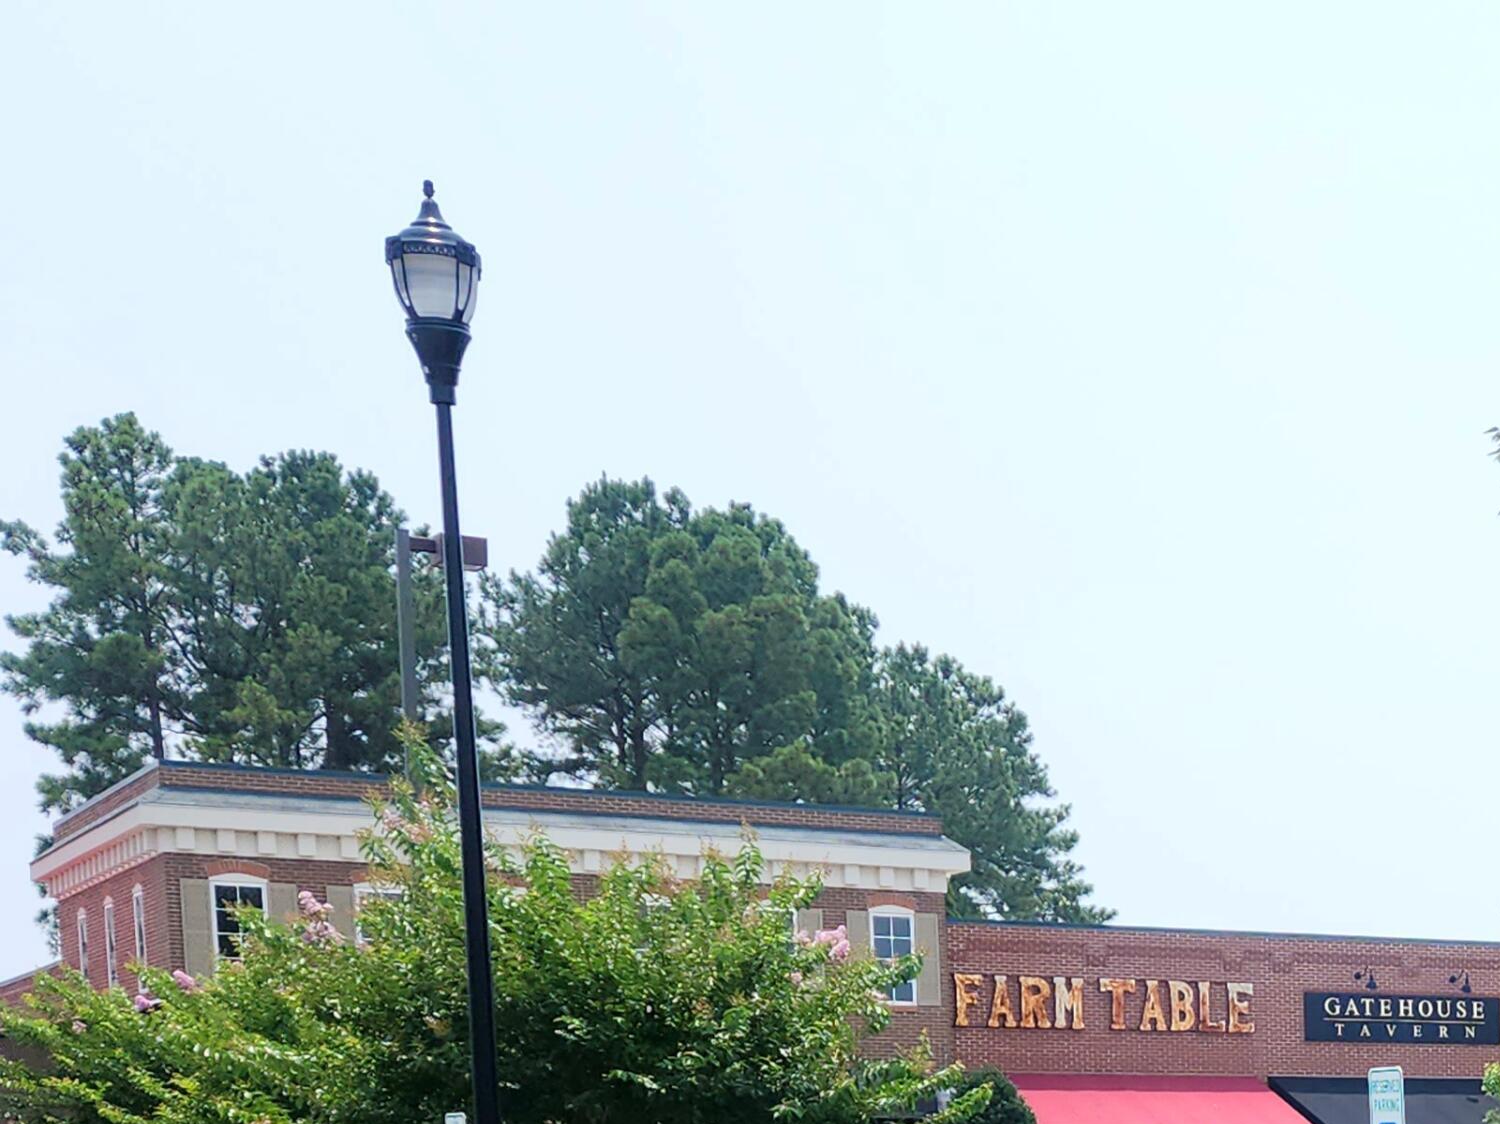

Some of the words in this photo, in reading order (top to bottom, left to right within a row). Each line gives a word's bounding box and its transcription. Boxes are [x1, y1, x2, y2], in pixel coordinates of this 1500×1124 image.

[952, 973, 1085, 1030] FARM
[1099, 977, 1255, 1033] TABLE
[1323, 997, 1485, 1019] GATEHOUSE
[1334, 1023, 1476, 1039] TAVERN
